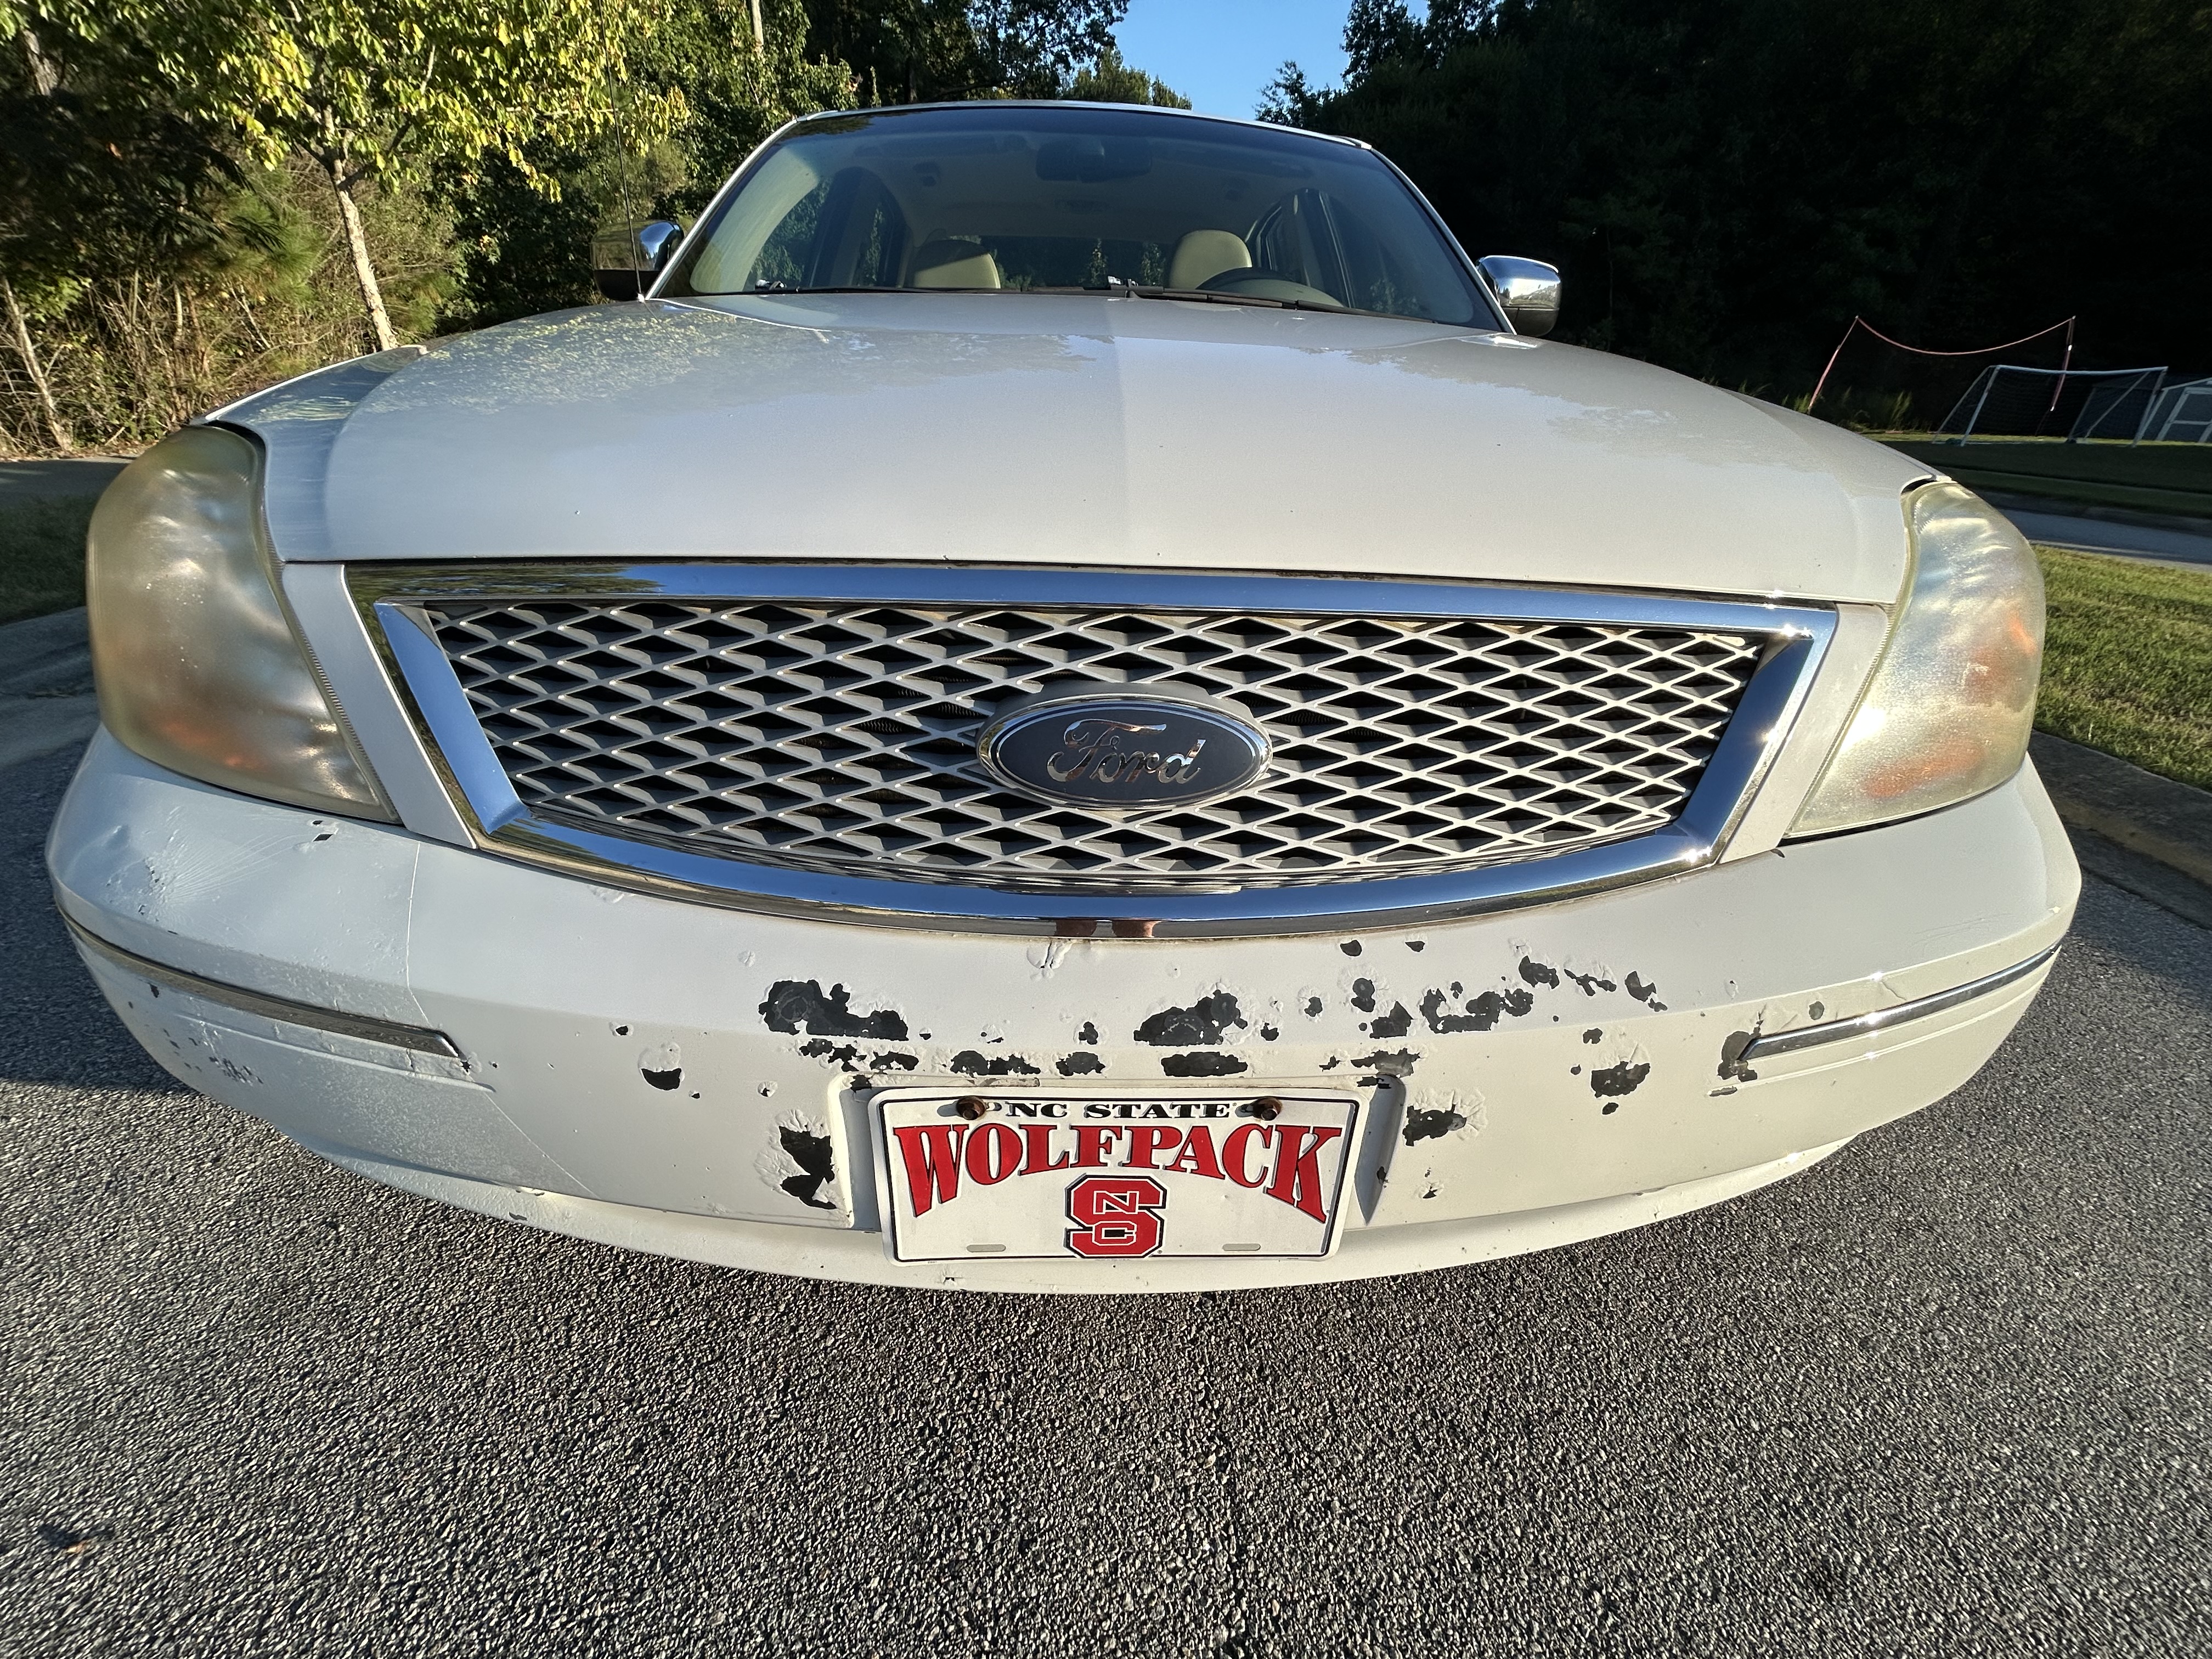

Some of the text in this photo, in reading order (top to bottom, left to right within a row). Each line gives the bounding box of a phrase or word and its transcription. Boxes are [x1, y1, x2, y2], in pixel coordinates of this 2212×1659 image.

[1047, 718, 1206, 784] Ford
[1006, 1102, 1230, 1119] NC STATE
[893, 1122, 1342, 1223] WOLFPACK
